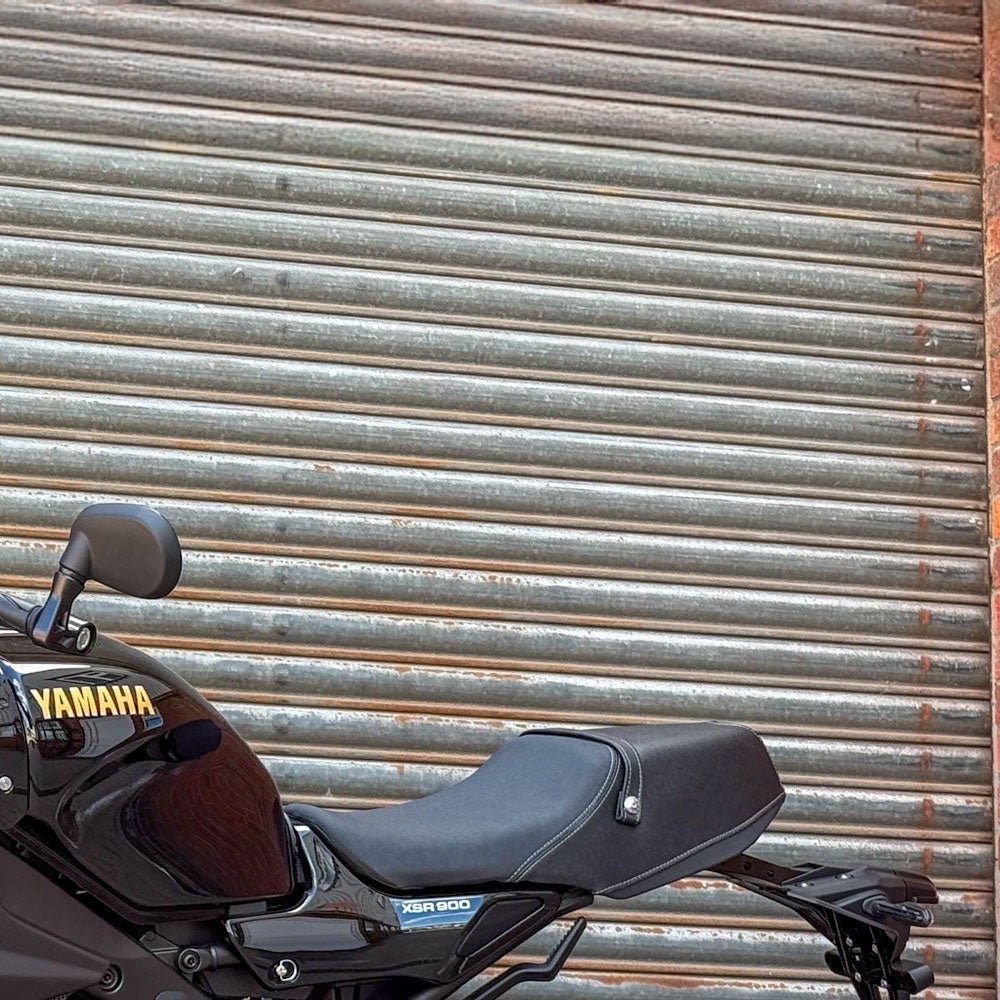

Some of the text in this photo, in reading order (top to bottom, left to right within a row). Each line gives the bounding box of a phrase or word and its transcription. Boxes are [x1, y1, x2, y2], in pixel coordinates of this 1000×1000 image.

[30, 685, 155, 720] YAMAHA
[402, 899, 471, 914] XSR 900
